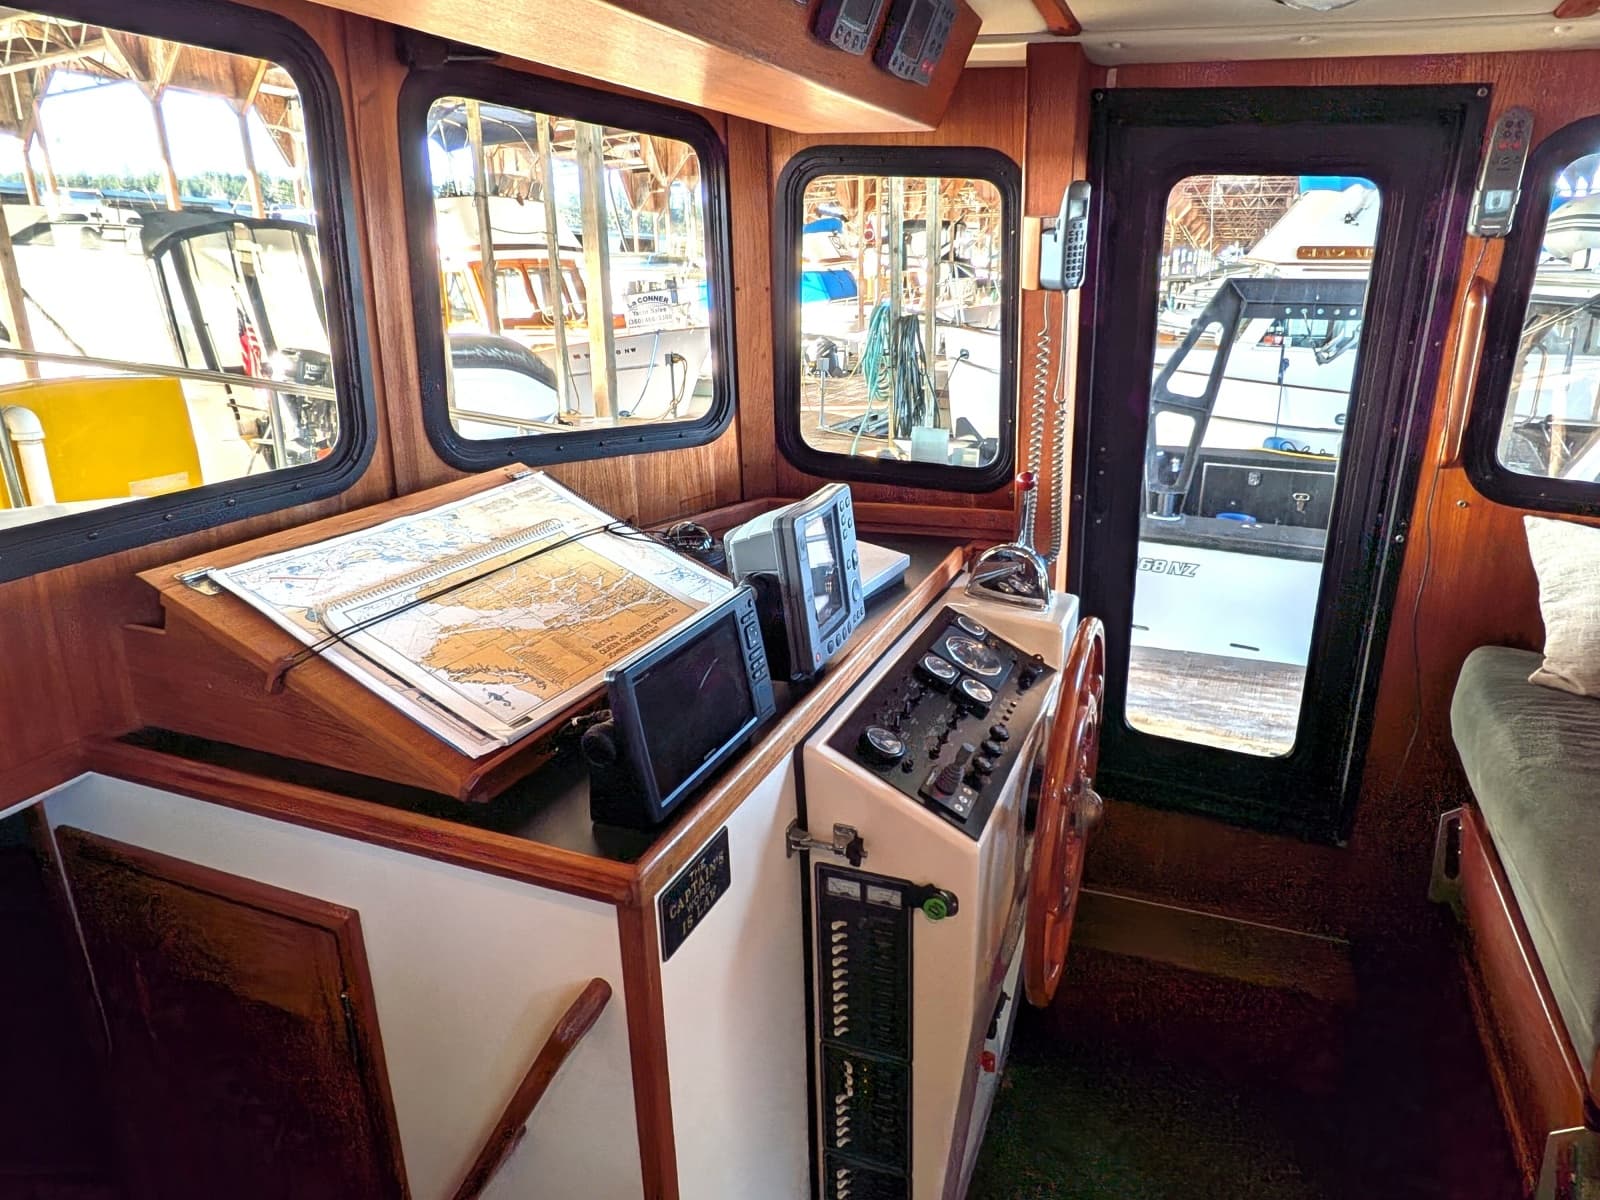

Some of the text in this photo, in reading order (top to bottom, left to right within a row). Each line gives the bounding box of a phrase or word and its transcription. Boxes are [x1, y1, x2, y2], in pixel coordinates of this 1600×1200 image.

[1166, 561, 1200, 577] NZ
[592, 635, 619, 650] SECTION
[599, 641, 621, 655] QUEEN
[620, 622, 652, 643] CHARLOTTE
[650, 611, 671, 625] STRAIT
[640, 625, 660, 639] STRAIT
[688, 857, 706, 880] THE
[669, 850, 724, 919] CAPTAIN'S
[686, 881, 711, 913] WORD
[682, 884, 717, 935] IS LAW
